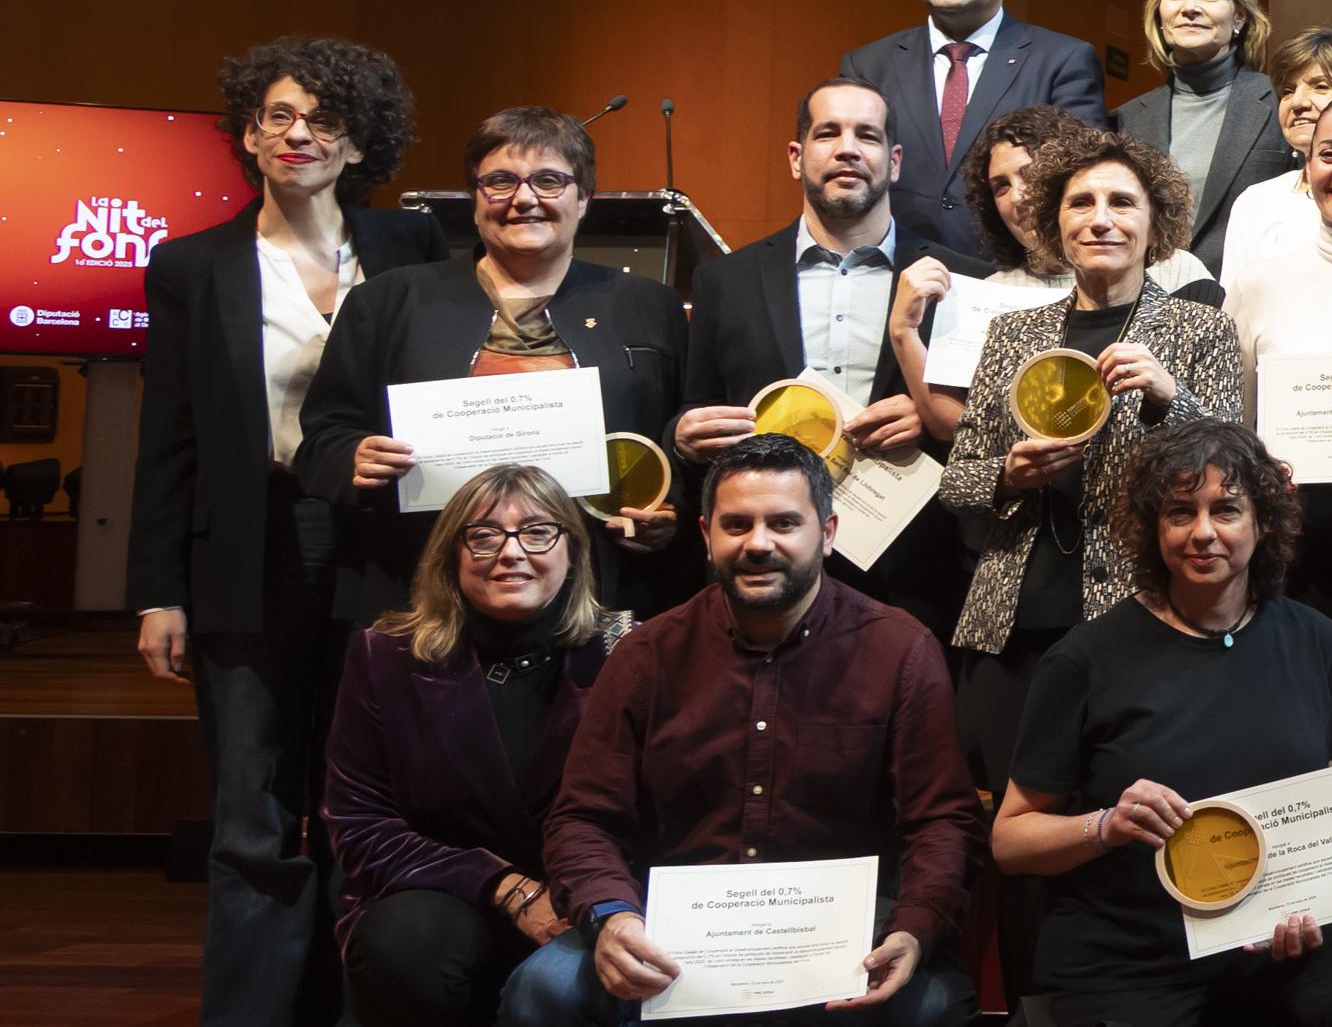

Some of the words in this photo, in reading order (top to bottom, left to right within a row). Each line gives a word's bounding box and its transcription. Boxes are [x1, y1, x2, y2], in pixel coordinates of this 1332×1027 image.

[91, 196, 109, 207] La
[77, 198, 146, 235] Nit
[463, 398, 491, 408] Segell
[494, 396, 508, 404] del
[503, 401, 563, 412] Municipalista
[1271, 807, 1286, 818] del
[1288, 800, 1311, 814] 0,7%
[1267, 851, 1277, 859] de
[1278, 848, 1286, 857] la
[1287, 844, 1307, 854] Roca
[1307, 839, 1319, 849] del
[726, 889, 758, 899] Segell
[760, 888, 776, 897] del
[691, 901, 704, 910] de
[706, 899, 766, 910] Cooperació
[768, 895, 835, 907] Municipalista
[705, 929, 752, 939] Ajuntament
[753, 928, 764, 936] de
